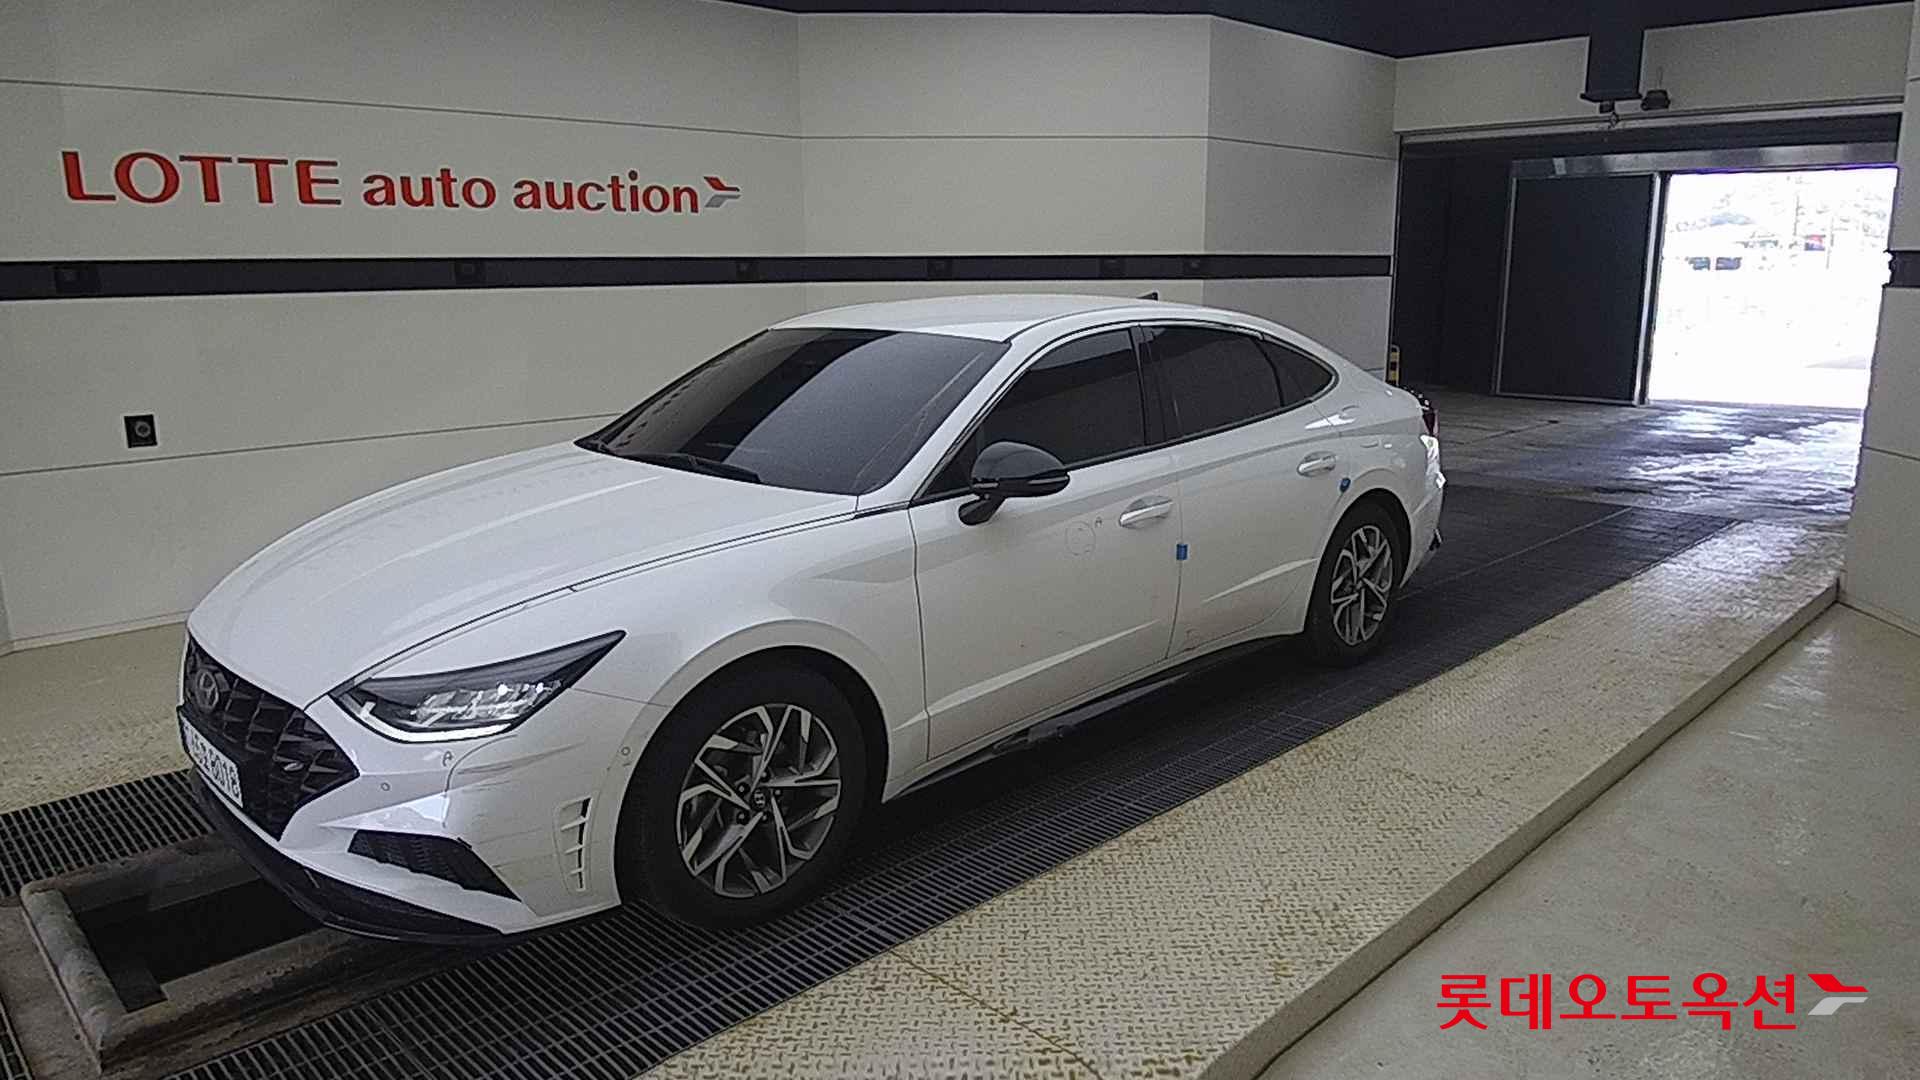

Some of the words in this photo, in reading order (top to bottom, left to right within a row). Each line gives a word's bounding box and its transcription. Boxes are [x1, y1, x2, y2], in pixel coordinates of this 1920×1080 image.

[63, 152, 342, 206] LOTTE
[362, 168, 497, 209] auto
[512, 170, 699, 214] auction
